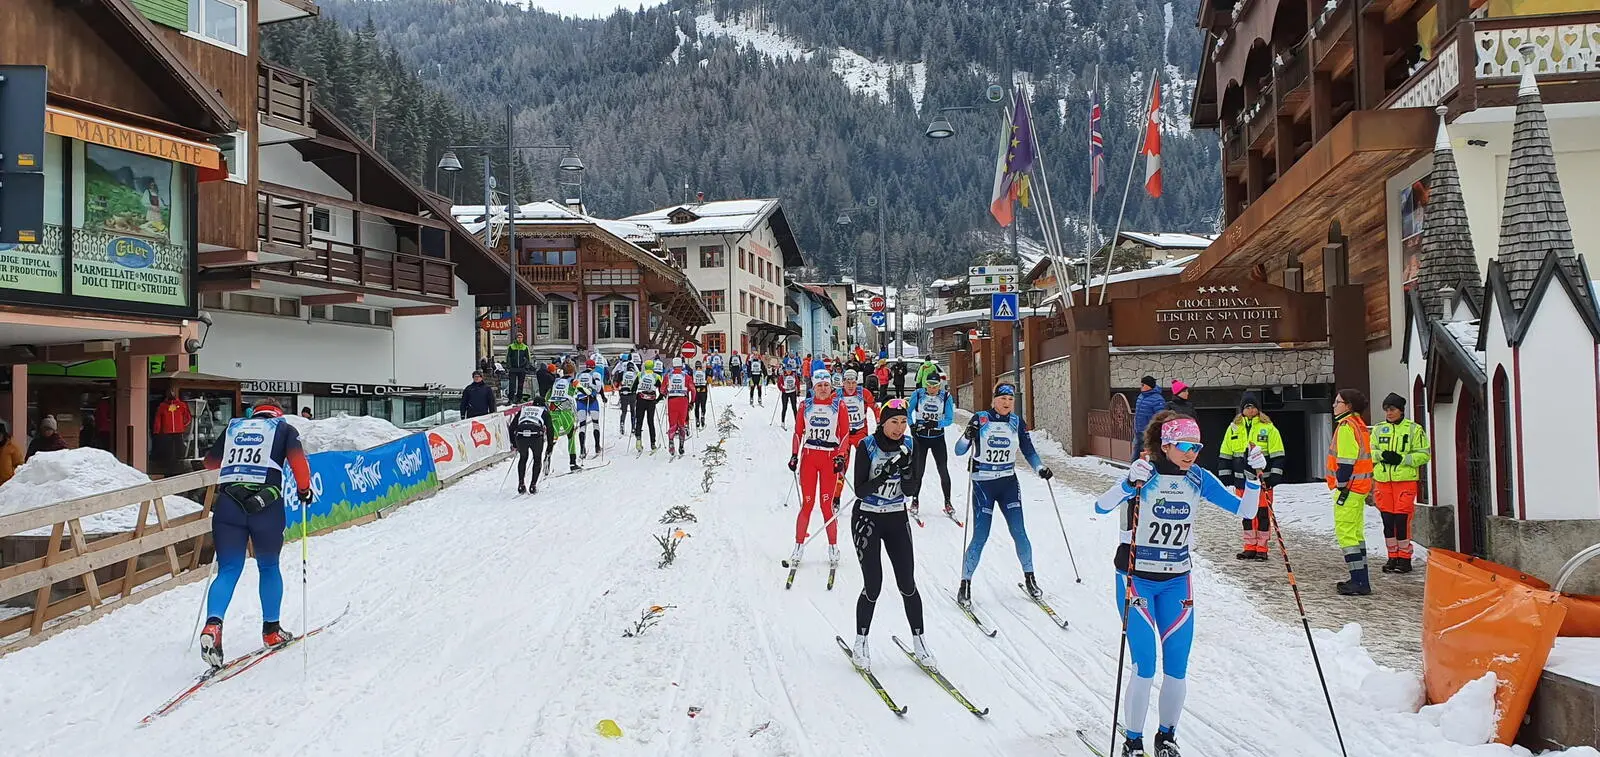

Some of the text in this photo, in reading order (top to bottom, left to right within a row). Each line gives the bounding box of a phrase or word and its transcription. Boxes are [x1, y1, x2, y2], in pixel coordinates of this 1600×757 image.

[75, 119, 202, 164] MARMELLATE
[115, 239, 149, 258] Eder
[0, 254, 51, 268] DIGE TIPICAL
[10, 265, 58, 278] PRODUCTION
[73, 263, 180, 286] MARMELLATE MOSTARD
[82, 275, 178, 296] DOLCI TIPICI STRUDEL
[1176, 297, 1260, 308] CROCE BIANCA
[1156, 310, 1281, 322] LEISURE & SPA HOTEL
[1169, 324, 1270, 341] GARAGE
[251, 381, 300, 393] BORELLI
[809, 428, 830, 440] 3139
[228, 448, 262, 464] 3136
[986, 449, 1011, 463] 3229
[1154, 503, 1189, 515] Melinda
[1148, 521, 1191, 546] 2927
